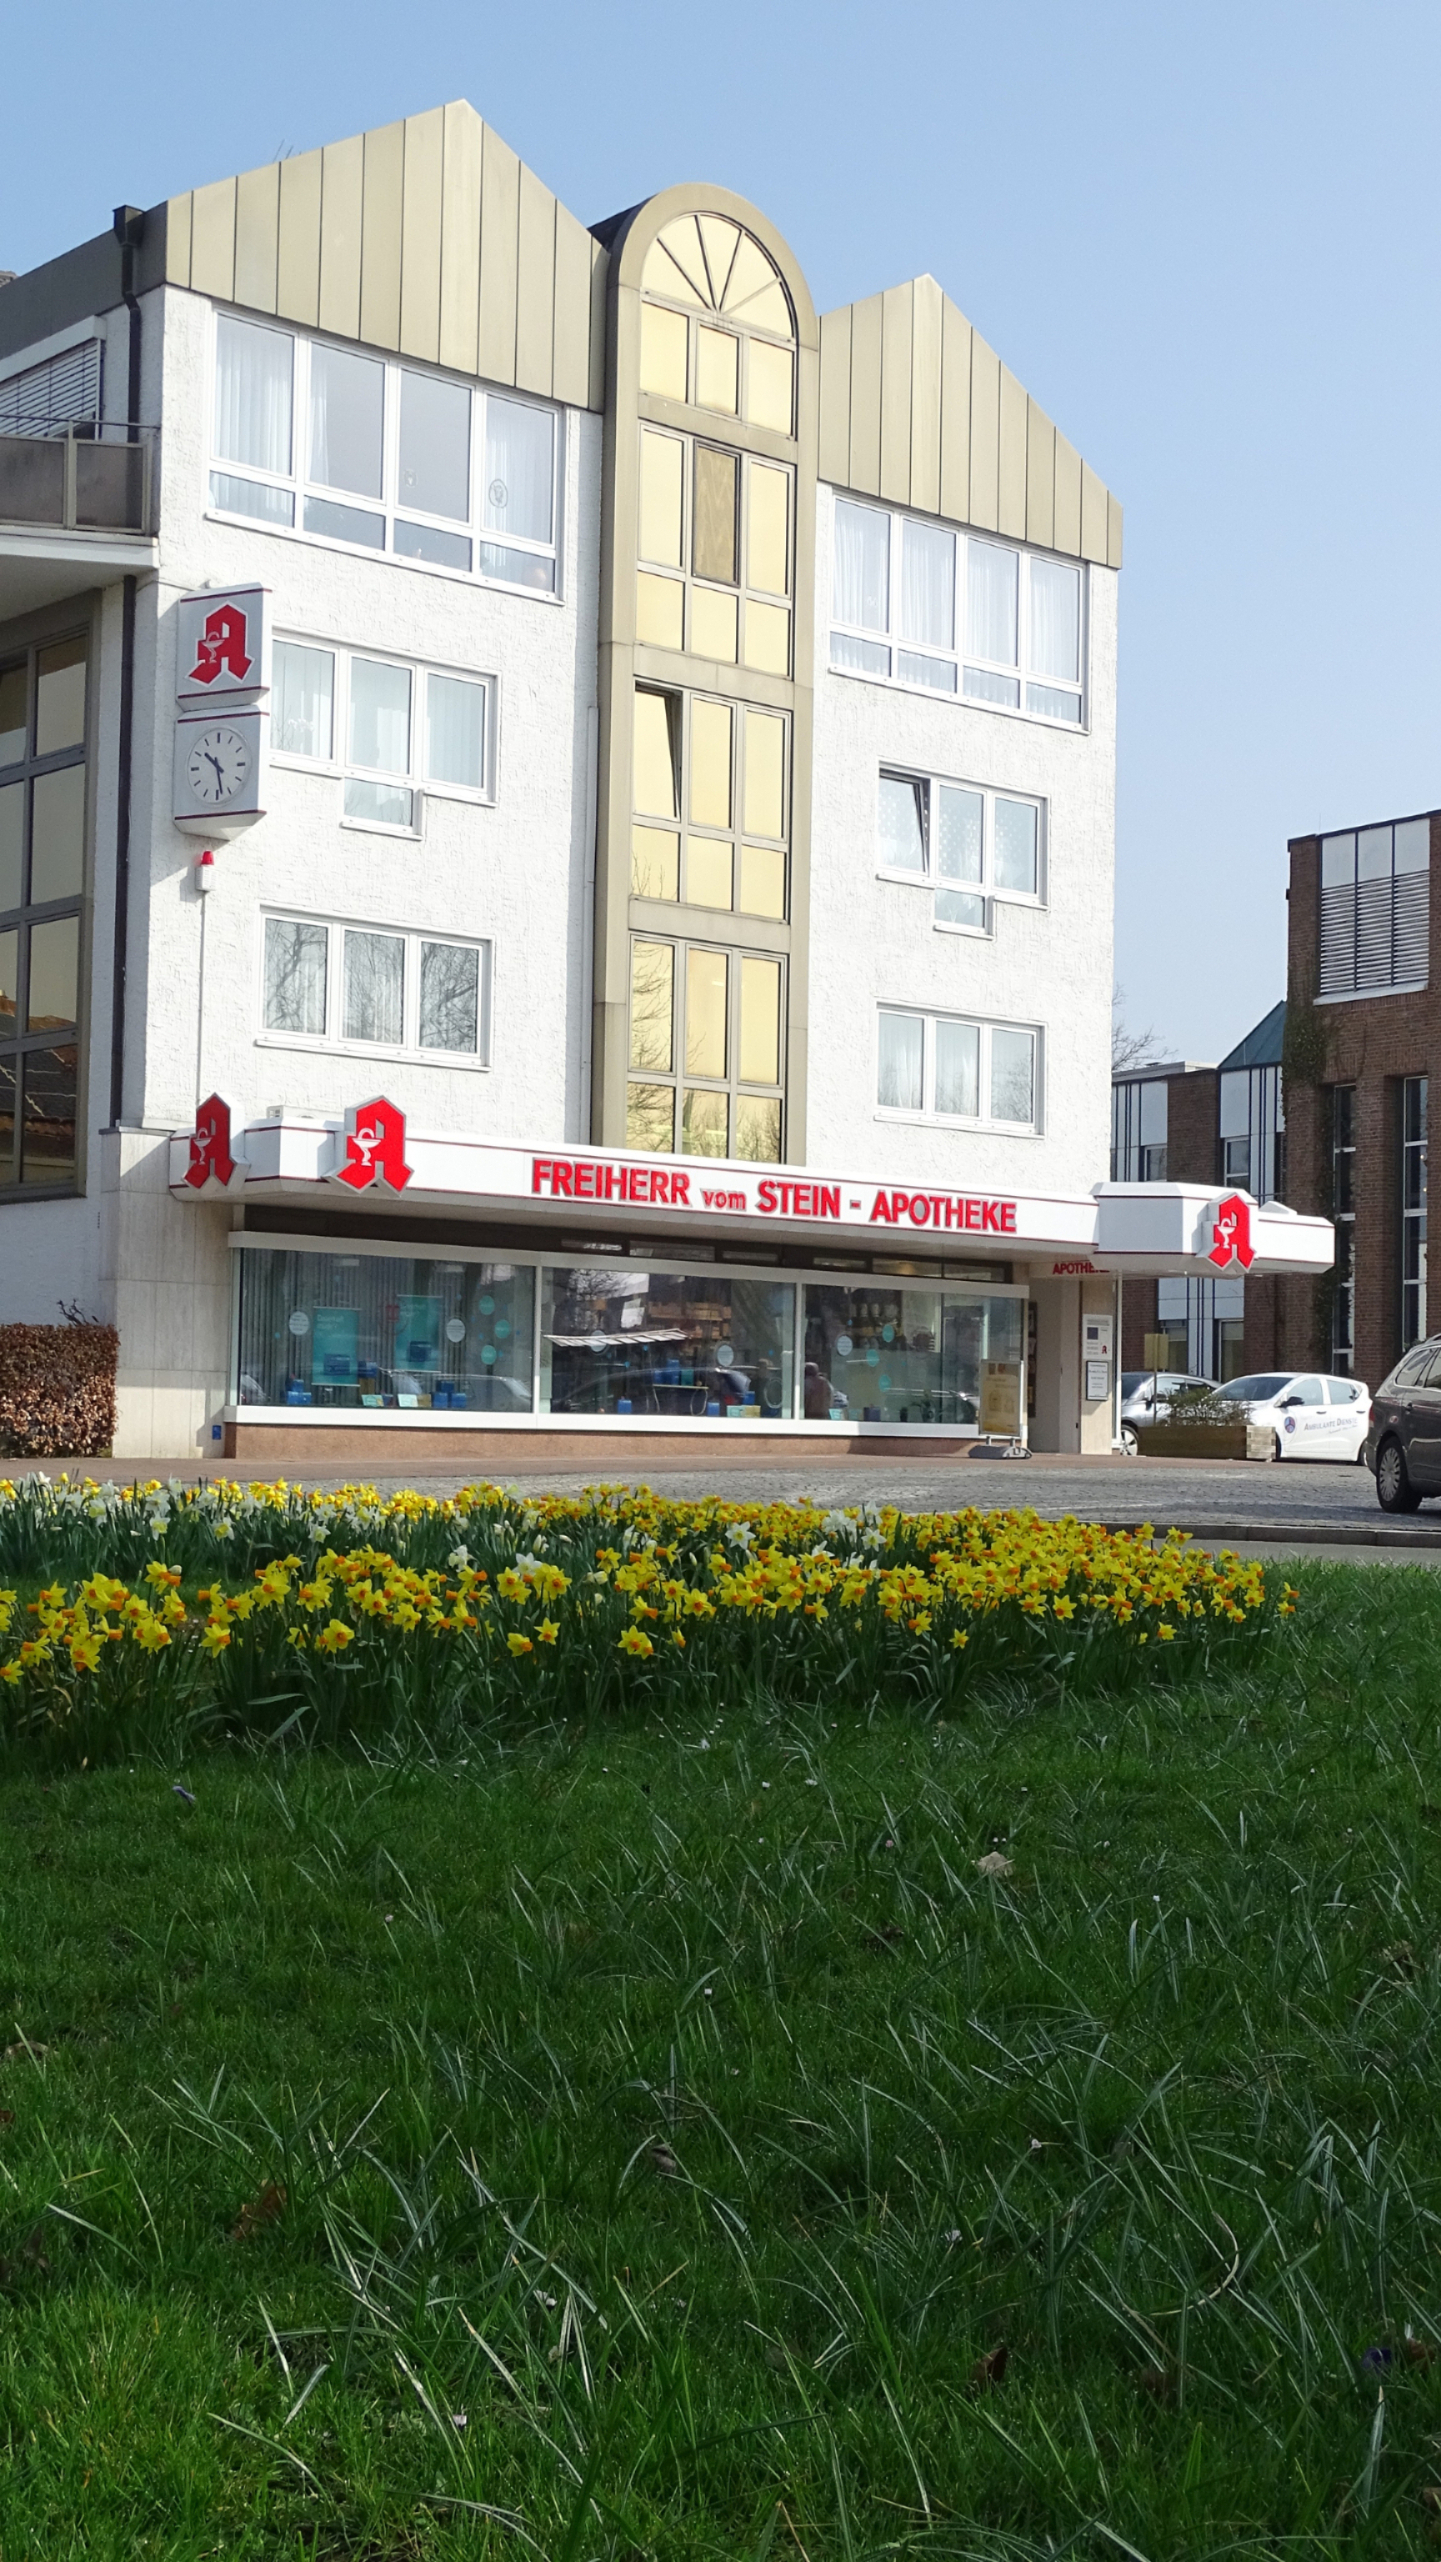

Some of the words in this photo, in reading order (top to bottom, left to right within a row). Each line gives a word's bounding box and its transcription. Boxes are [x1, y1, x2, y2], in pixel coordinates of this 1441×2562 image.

[532, 1157, 691, 1207] FREIHERR
[701, 1188, 746, 1211] vom
[756, 1178, 841, 1219] STEIN
[869, 1189, 1018, 1234] APOTHEKE
[1052, 1261, 1110, 1275] APOTHE
